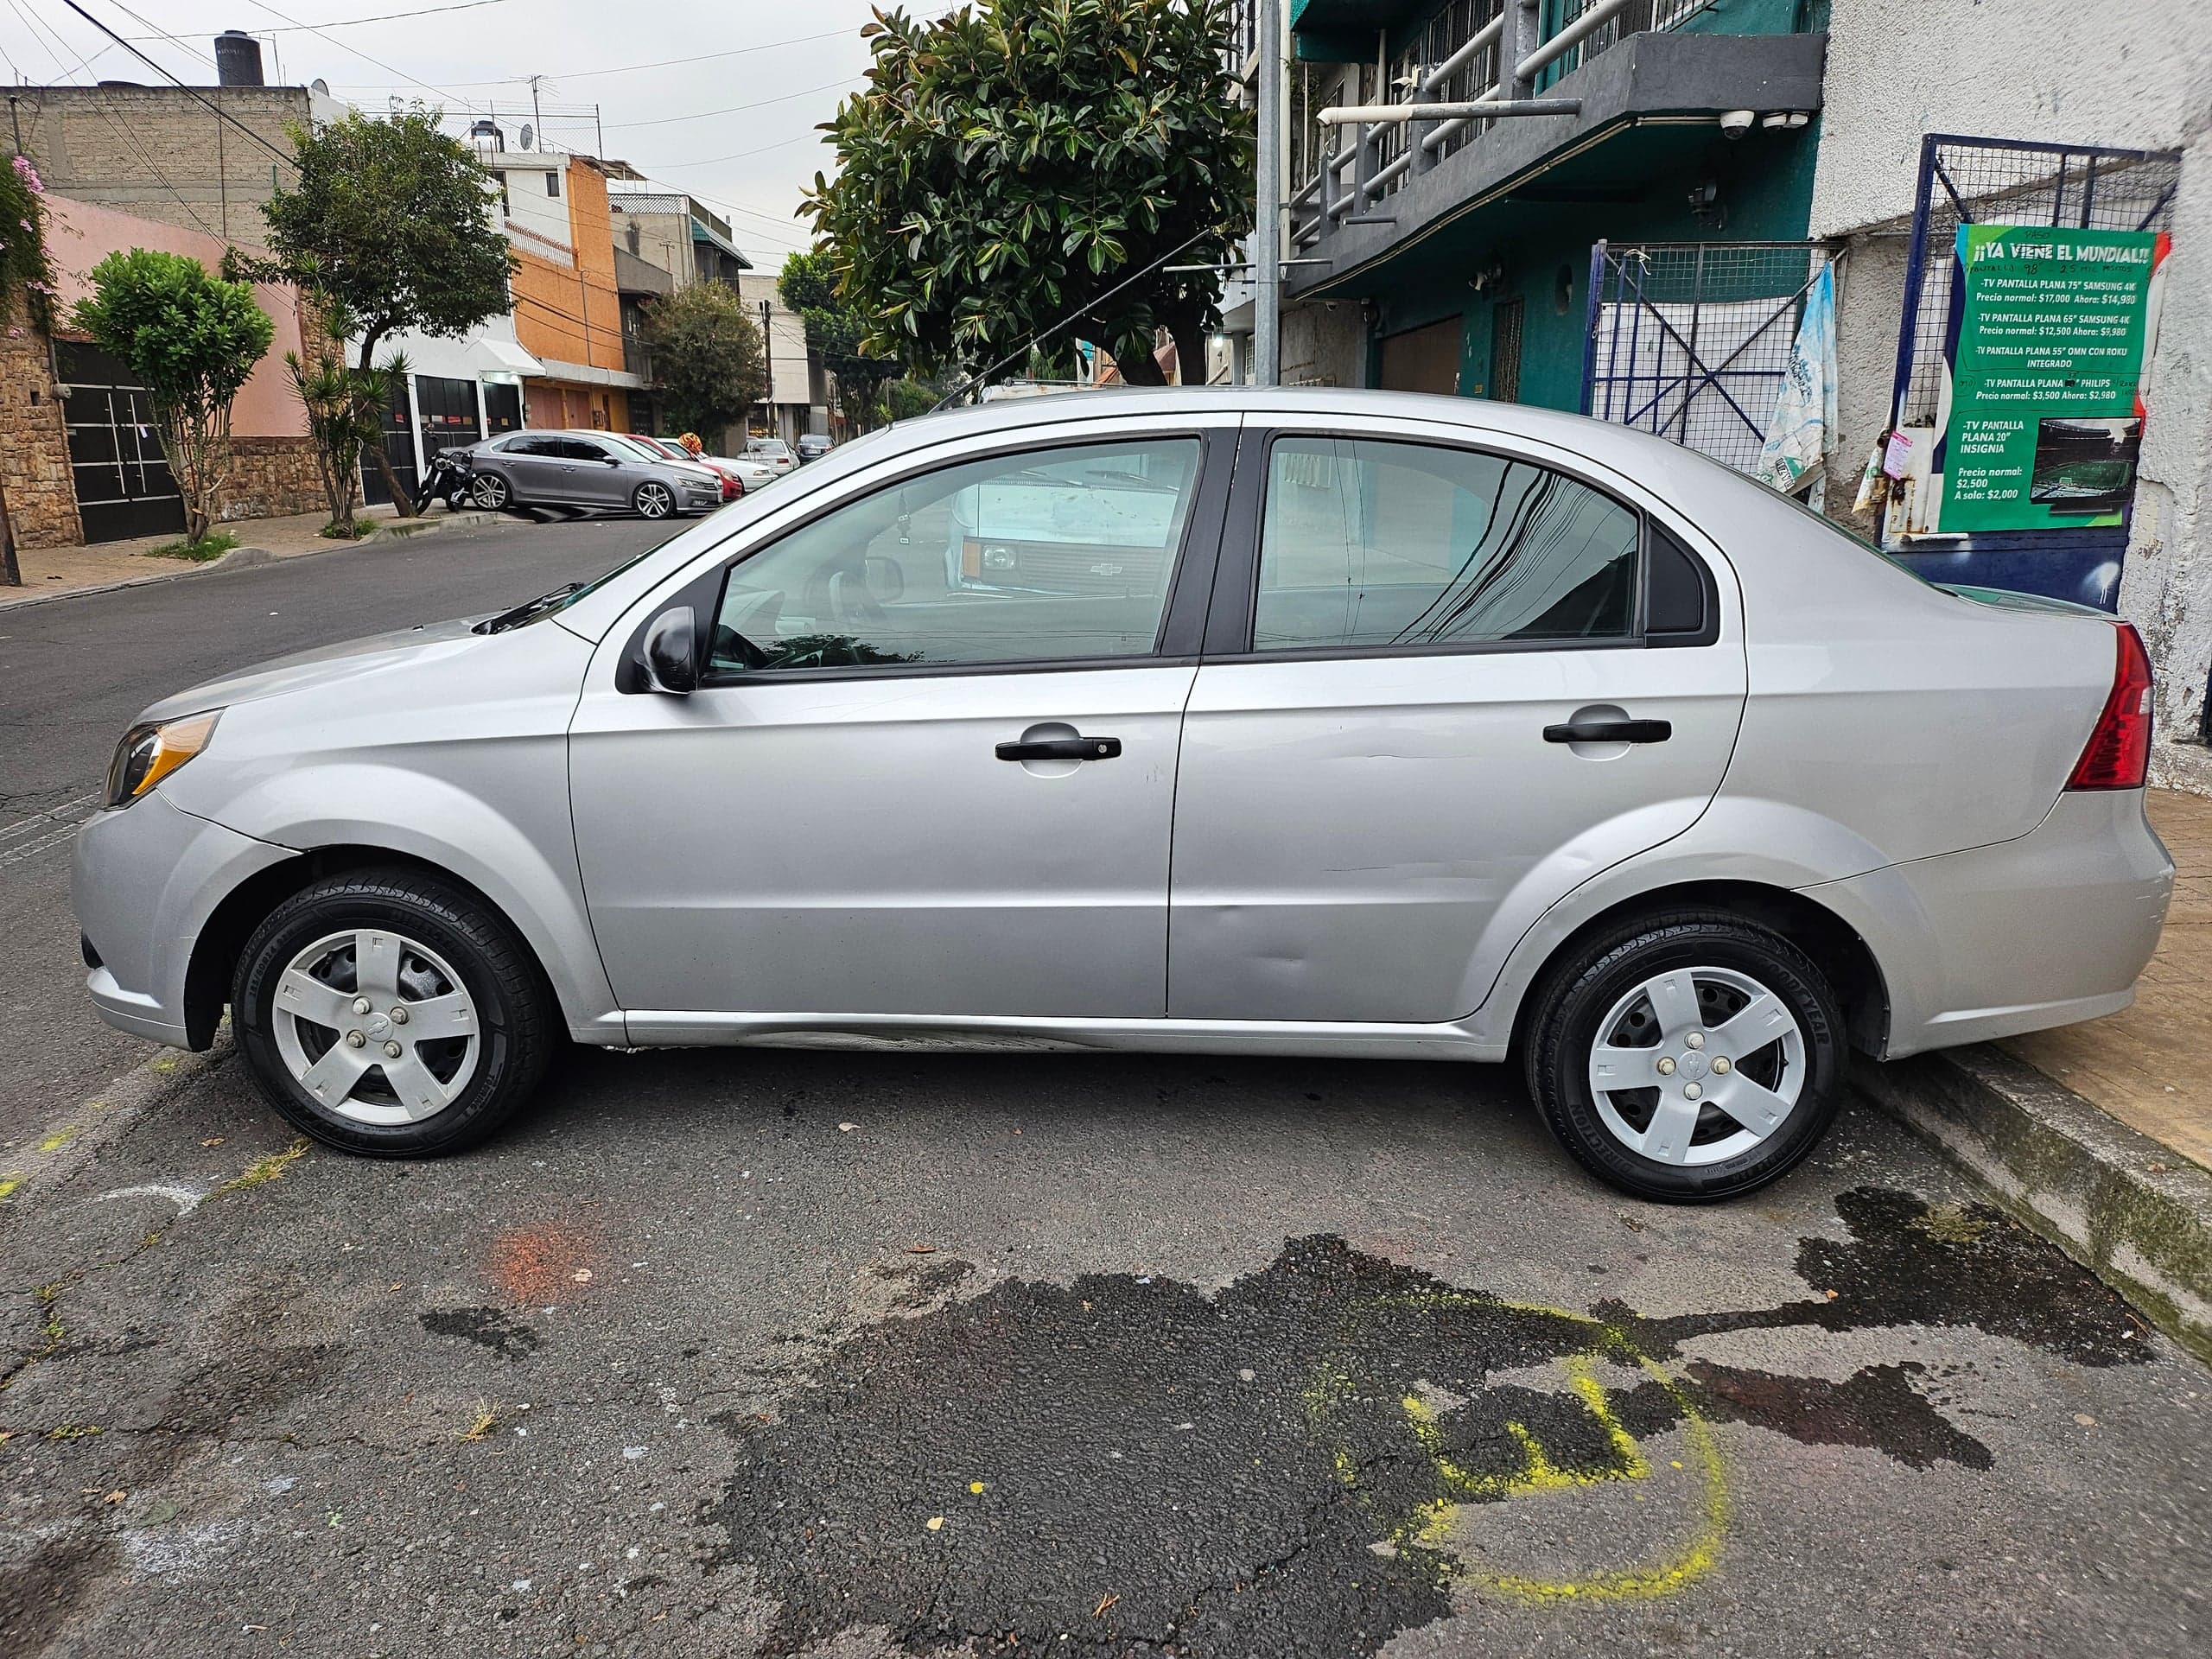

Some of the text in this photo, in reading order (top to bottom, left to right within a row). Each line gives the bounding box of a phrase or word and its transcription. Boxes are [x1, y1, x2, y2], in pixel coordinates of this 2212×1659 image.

[2056, 245, 2073, 261] EL
[2075, 245, 2149, 264] MUNDIAL!!
[1980, 279, 1995, 288] -TV
[1996, 279, 2038, 289] PANTALLA
[2039, 281, 2066, 289] PLANA
[2083, 282, 2122, 291] SAMSUNG
[2123, 283, 2137, 291] 4K
[1976, 293, 2136, 305] Precio normal: $17,000 Ahora: $14,980
[1978, 314, 1991, 322] -TV
[1992, 314, 2032, 323] PANTALLA
[2034, 315, 2062, 323] PLANA
[2078, 315, 2119, 324] SAMSUNG
[1979, 326, 2004, 334] Precio
[2005, 326, 2037, 335] normal:
[2038, 327, 2071, 336] $12,500
[2073, 327, 2099, 336] Ahora:
[1986, 346, 2024, 355] PANTALLA
[2025, 347, 2050, 356] PLANA
[2088, 347, 2106, 356] CON
[2026, 359, 2073, 368] INTEGRADO
[1996, 379, 2036, 388] PANTALLA
[2037, 379, 2063, 388] PLANA
[2081, 379, 2111, 388] PHILIPS
[1975, 391, 1999, 400] Precio
[2000, 391, 2031, 400] normal:
[2032, 391, 2061, 401] $3,500
[2062, 391, 2088, 400] Ahora:
[2088, 391, 2116, 401] $2,980
[1962, 421, 2024, 430] -TV PANTALLA
[1961, 433, 1995, 442] PLANA
[1960, 444, 2005, 454] INSIGNIA
[1958, 467, 2023, 477] Precio normal:
[1956, 479, 1988, 489] $2,500
[1954, 489, 2018, 500] A solo: $2,000
